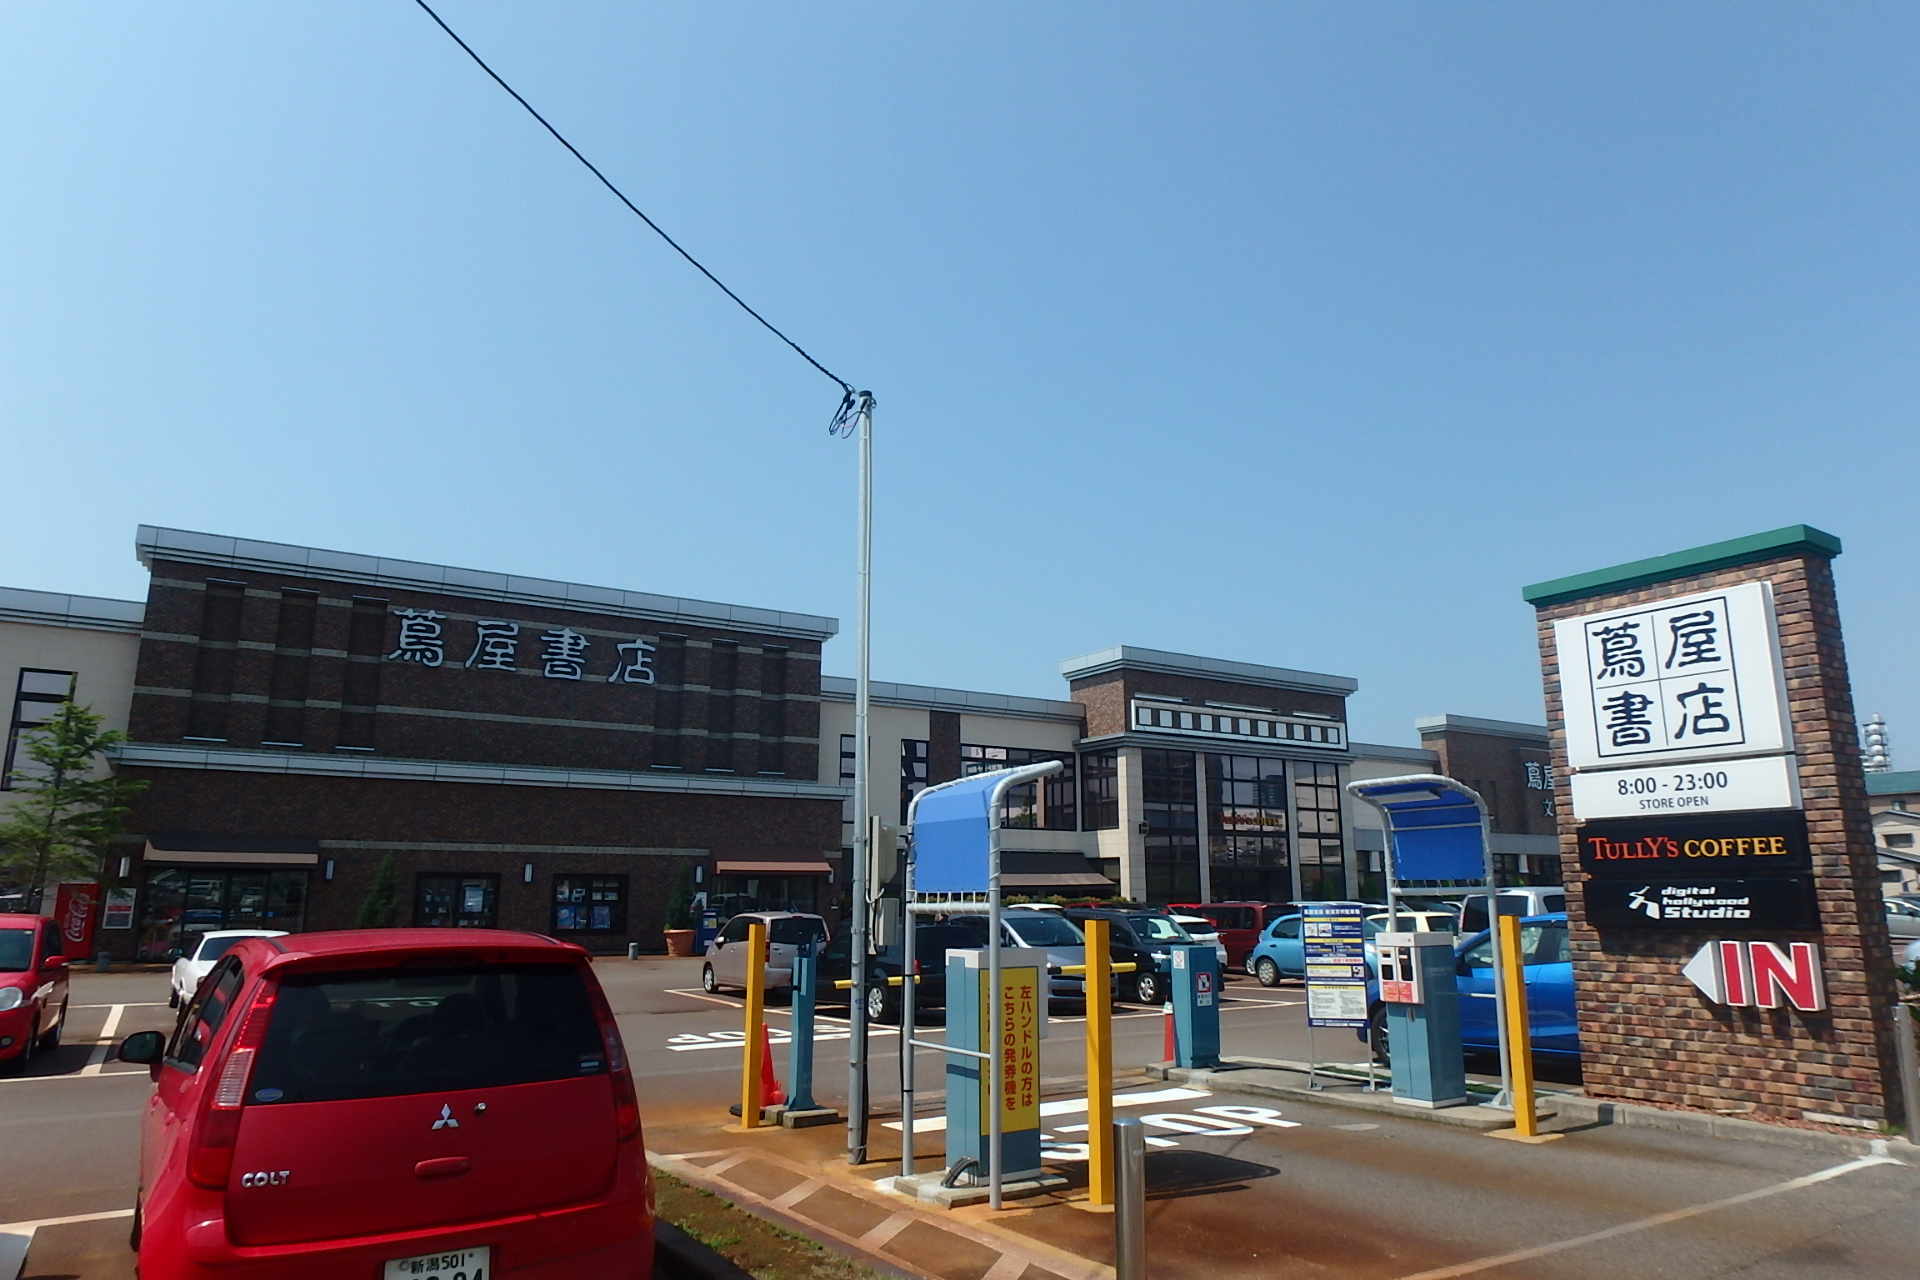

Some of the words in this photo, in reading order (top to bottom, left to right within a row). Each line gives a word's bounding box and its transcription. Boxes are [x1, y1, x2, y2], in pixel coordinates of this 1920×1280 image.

[388, 608, 656, 685] 蔦屋書店
[1592, 610, 1721, 680] 蔦屋
[1602, 682, 1730, 747] 書店
[1617, 777, 1657, 795] 8:00
[1674, 771, 1728, 791] 23:00
[1639, 797, 1675, 810] STORE
[1677, 795, 1709, 807] OPEN
[1684, 836, 1787, 858] COFFEE
[1661, 886, 1716, 898] digital
[1662, 896, 1750, 907] hollywood
[1664, 906, 1751, 919] Studio
[1719, 940, 1826, 1012] IN
[1004, 986, 1017, 1111] こちらの発券機を
[1020, 985, 1033, 1107] 左ハンドルの方は
[241, 1170, 290, 1188] COLT
